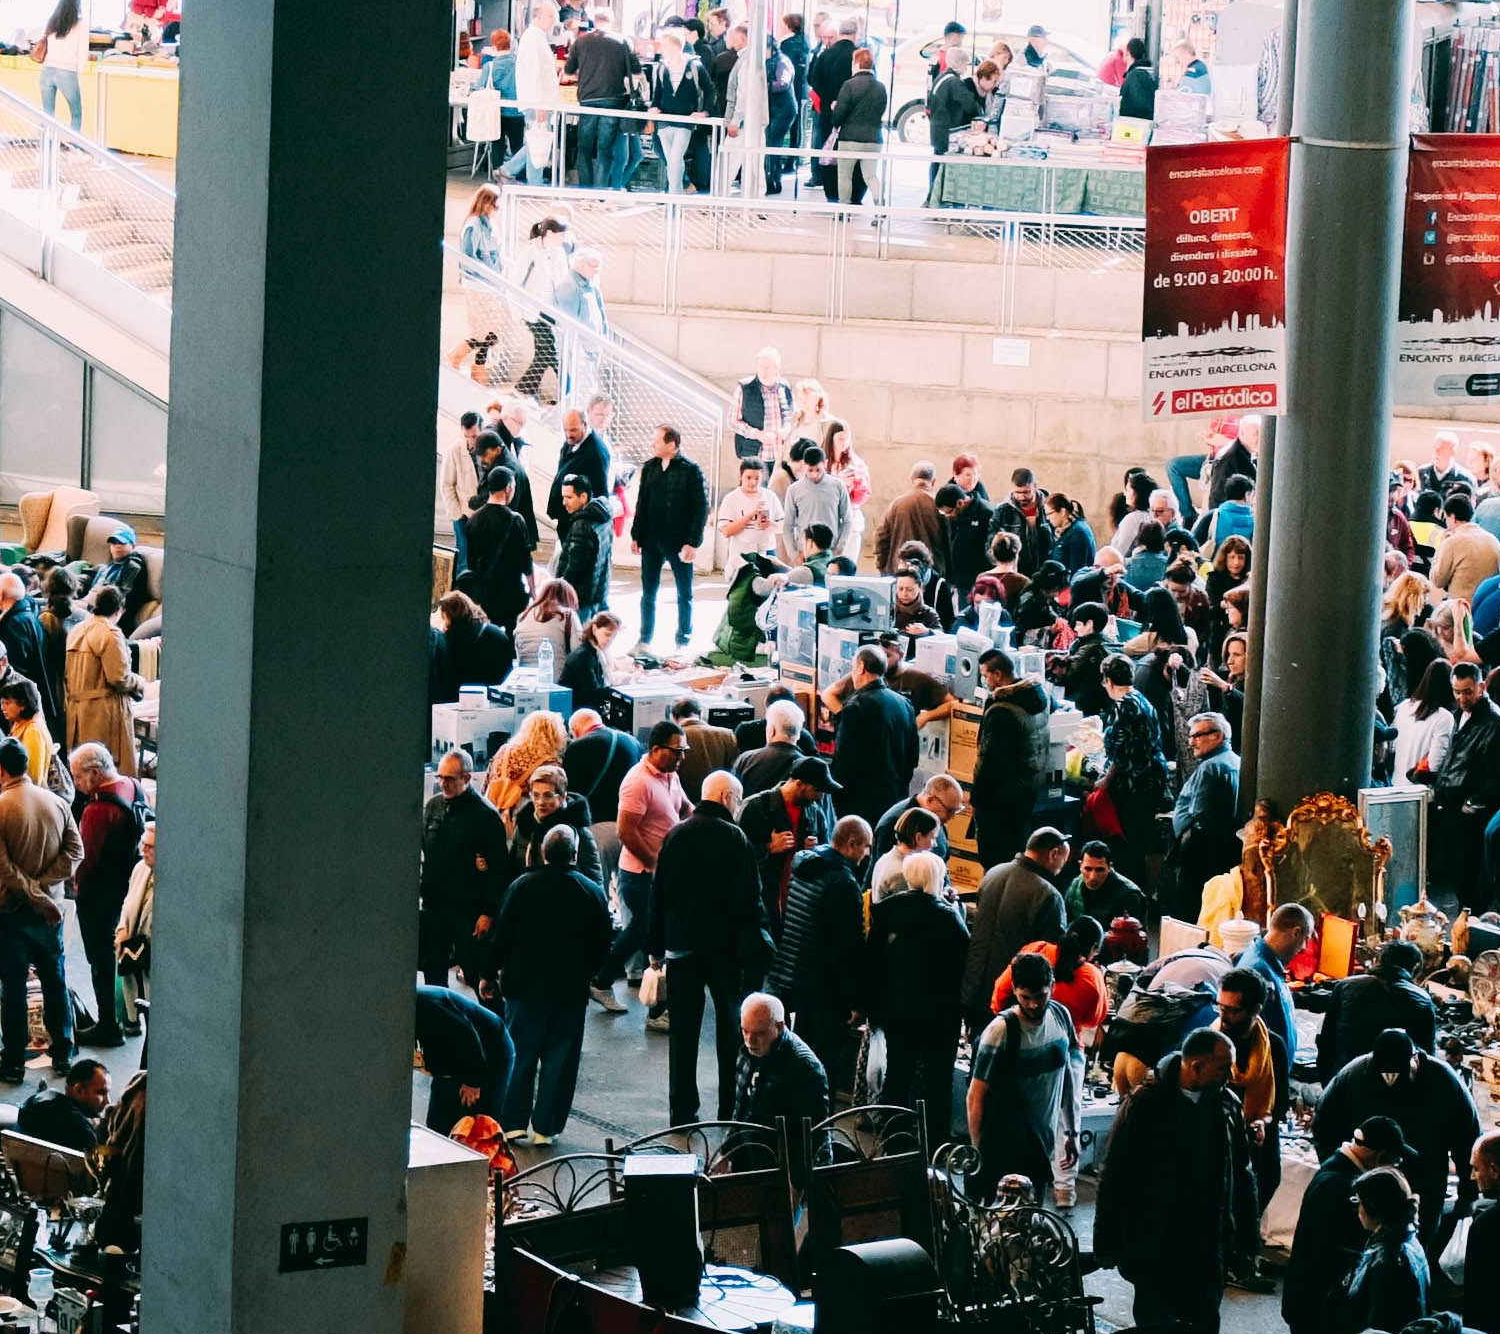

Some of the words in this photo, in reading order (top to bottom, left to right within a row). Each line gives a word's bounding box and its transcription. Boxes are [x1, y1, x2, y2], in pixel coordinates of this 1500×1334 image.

[1189, 207, 1239, 224] OBERT
[1154, 273, 1170, 288] de
[1174, 271, 1206, 287] 9:00
[1210, 273, 1219, 284] a
[1223, 267, 1261, 284] 20:00
[1399, 353, 1453, 363] ENCANTS
[1149, 367, 1202, 379] ENCANTS
[1208, 362, 1277, 375] BARCELONA
